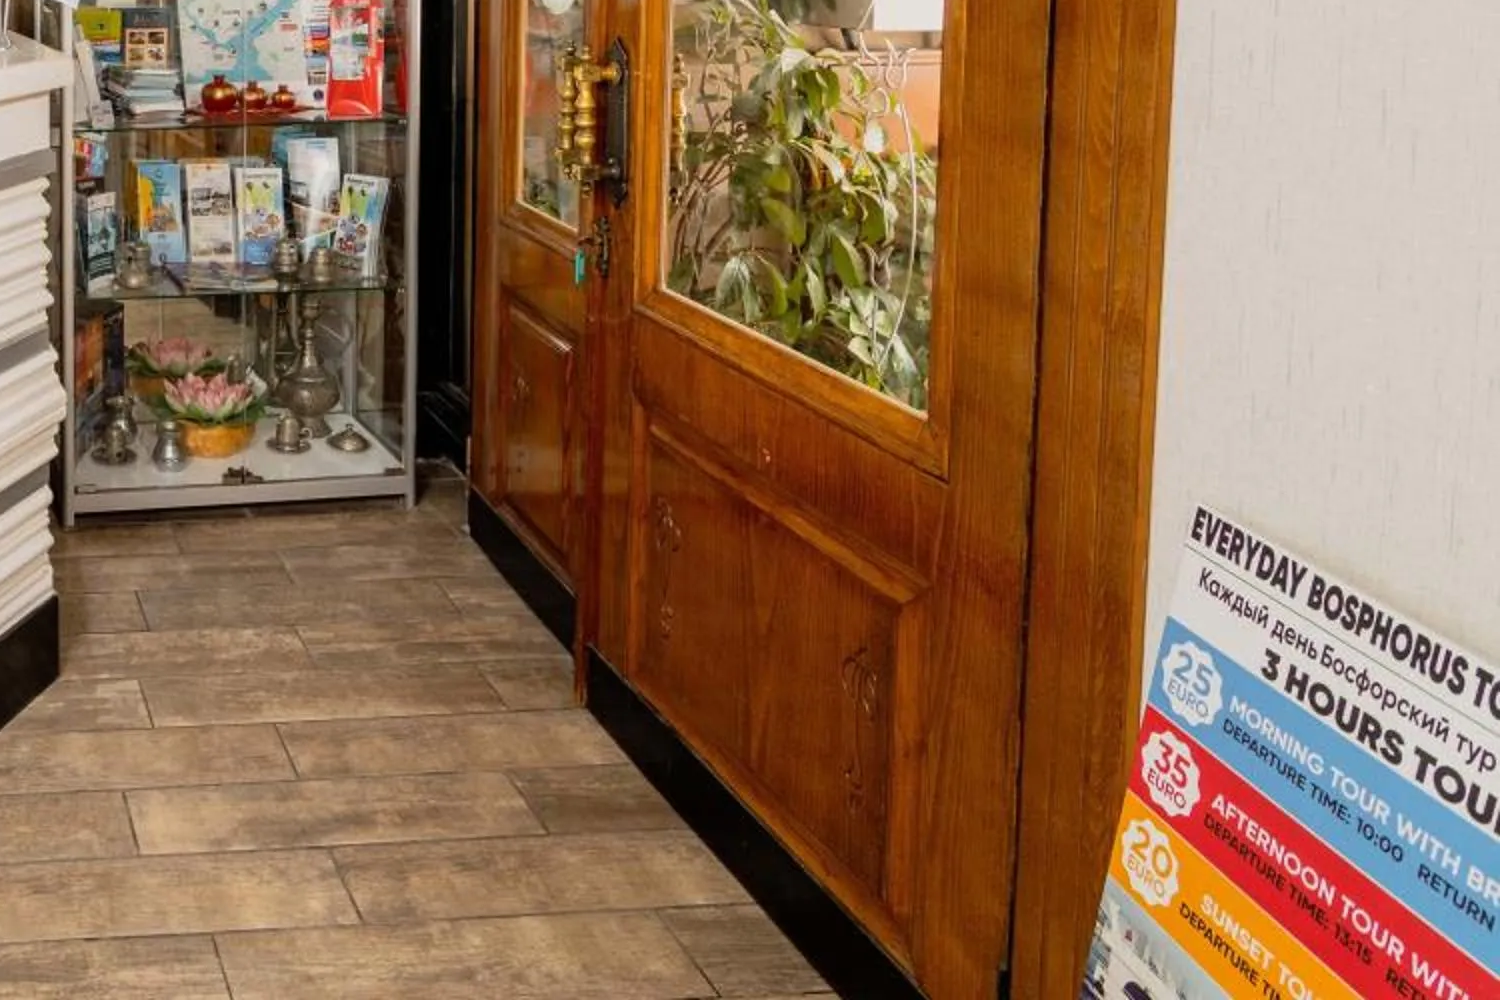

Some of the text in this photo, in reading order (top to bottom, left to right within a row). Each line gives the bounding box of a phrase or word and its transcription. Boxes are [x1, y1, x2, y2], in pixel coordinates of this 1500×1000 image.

[1191, 506, 1308, 599] EVERYDAY
[1307, 574, 1468, 695] BOSPHORUS
[1167, 677, 1209, 718] EURO
[1172, 651, 1213, 698] 25
[1199, 567, 1497, 772] Каждый день Босфорский тур
[1261, 648, 1281, 681] 3
[1284, 664, 1404, 765] HOURS
[1147, 768, 1187, 810] EURO
[1154, 739, 1190, 788] 35
[1229, 695, 1325, 775] MORNING
[1331, 765, 1391, 825] TOUR
[1396, 812, 1461, 876] WITH
[1130, 825, 1174, 879] 20
[1223, 717, 1496, 933] DEPARTURE TIME: 10:00 RETURN
[1127, 856, 1167, 898] EURO
[1203, 814, 1285, 893] DEPARTURE
[1290, 883, 1329, 930] TIME:
[1334, 922, 1372, 965] 13:15
[1211, 793, 1336, 907] AFTERNOON
[1341, 895, 1405, 965] TOUR
[1180, 902, 1259, 986] DEPARTURE
[1200, 893, 1275, 971] SUNSET
